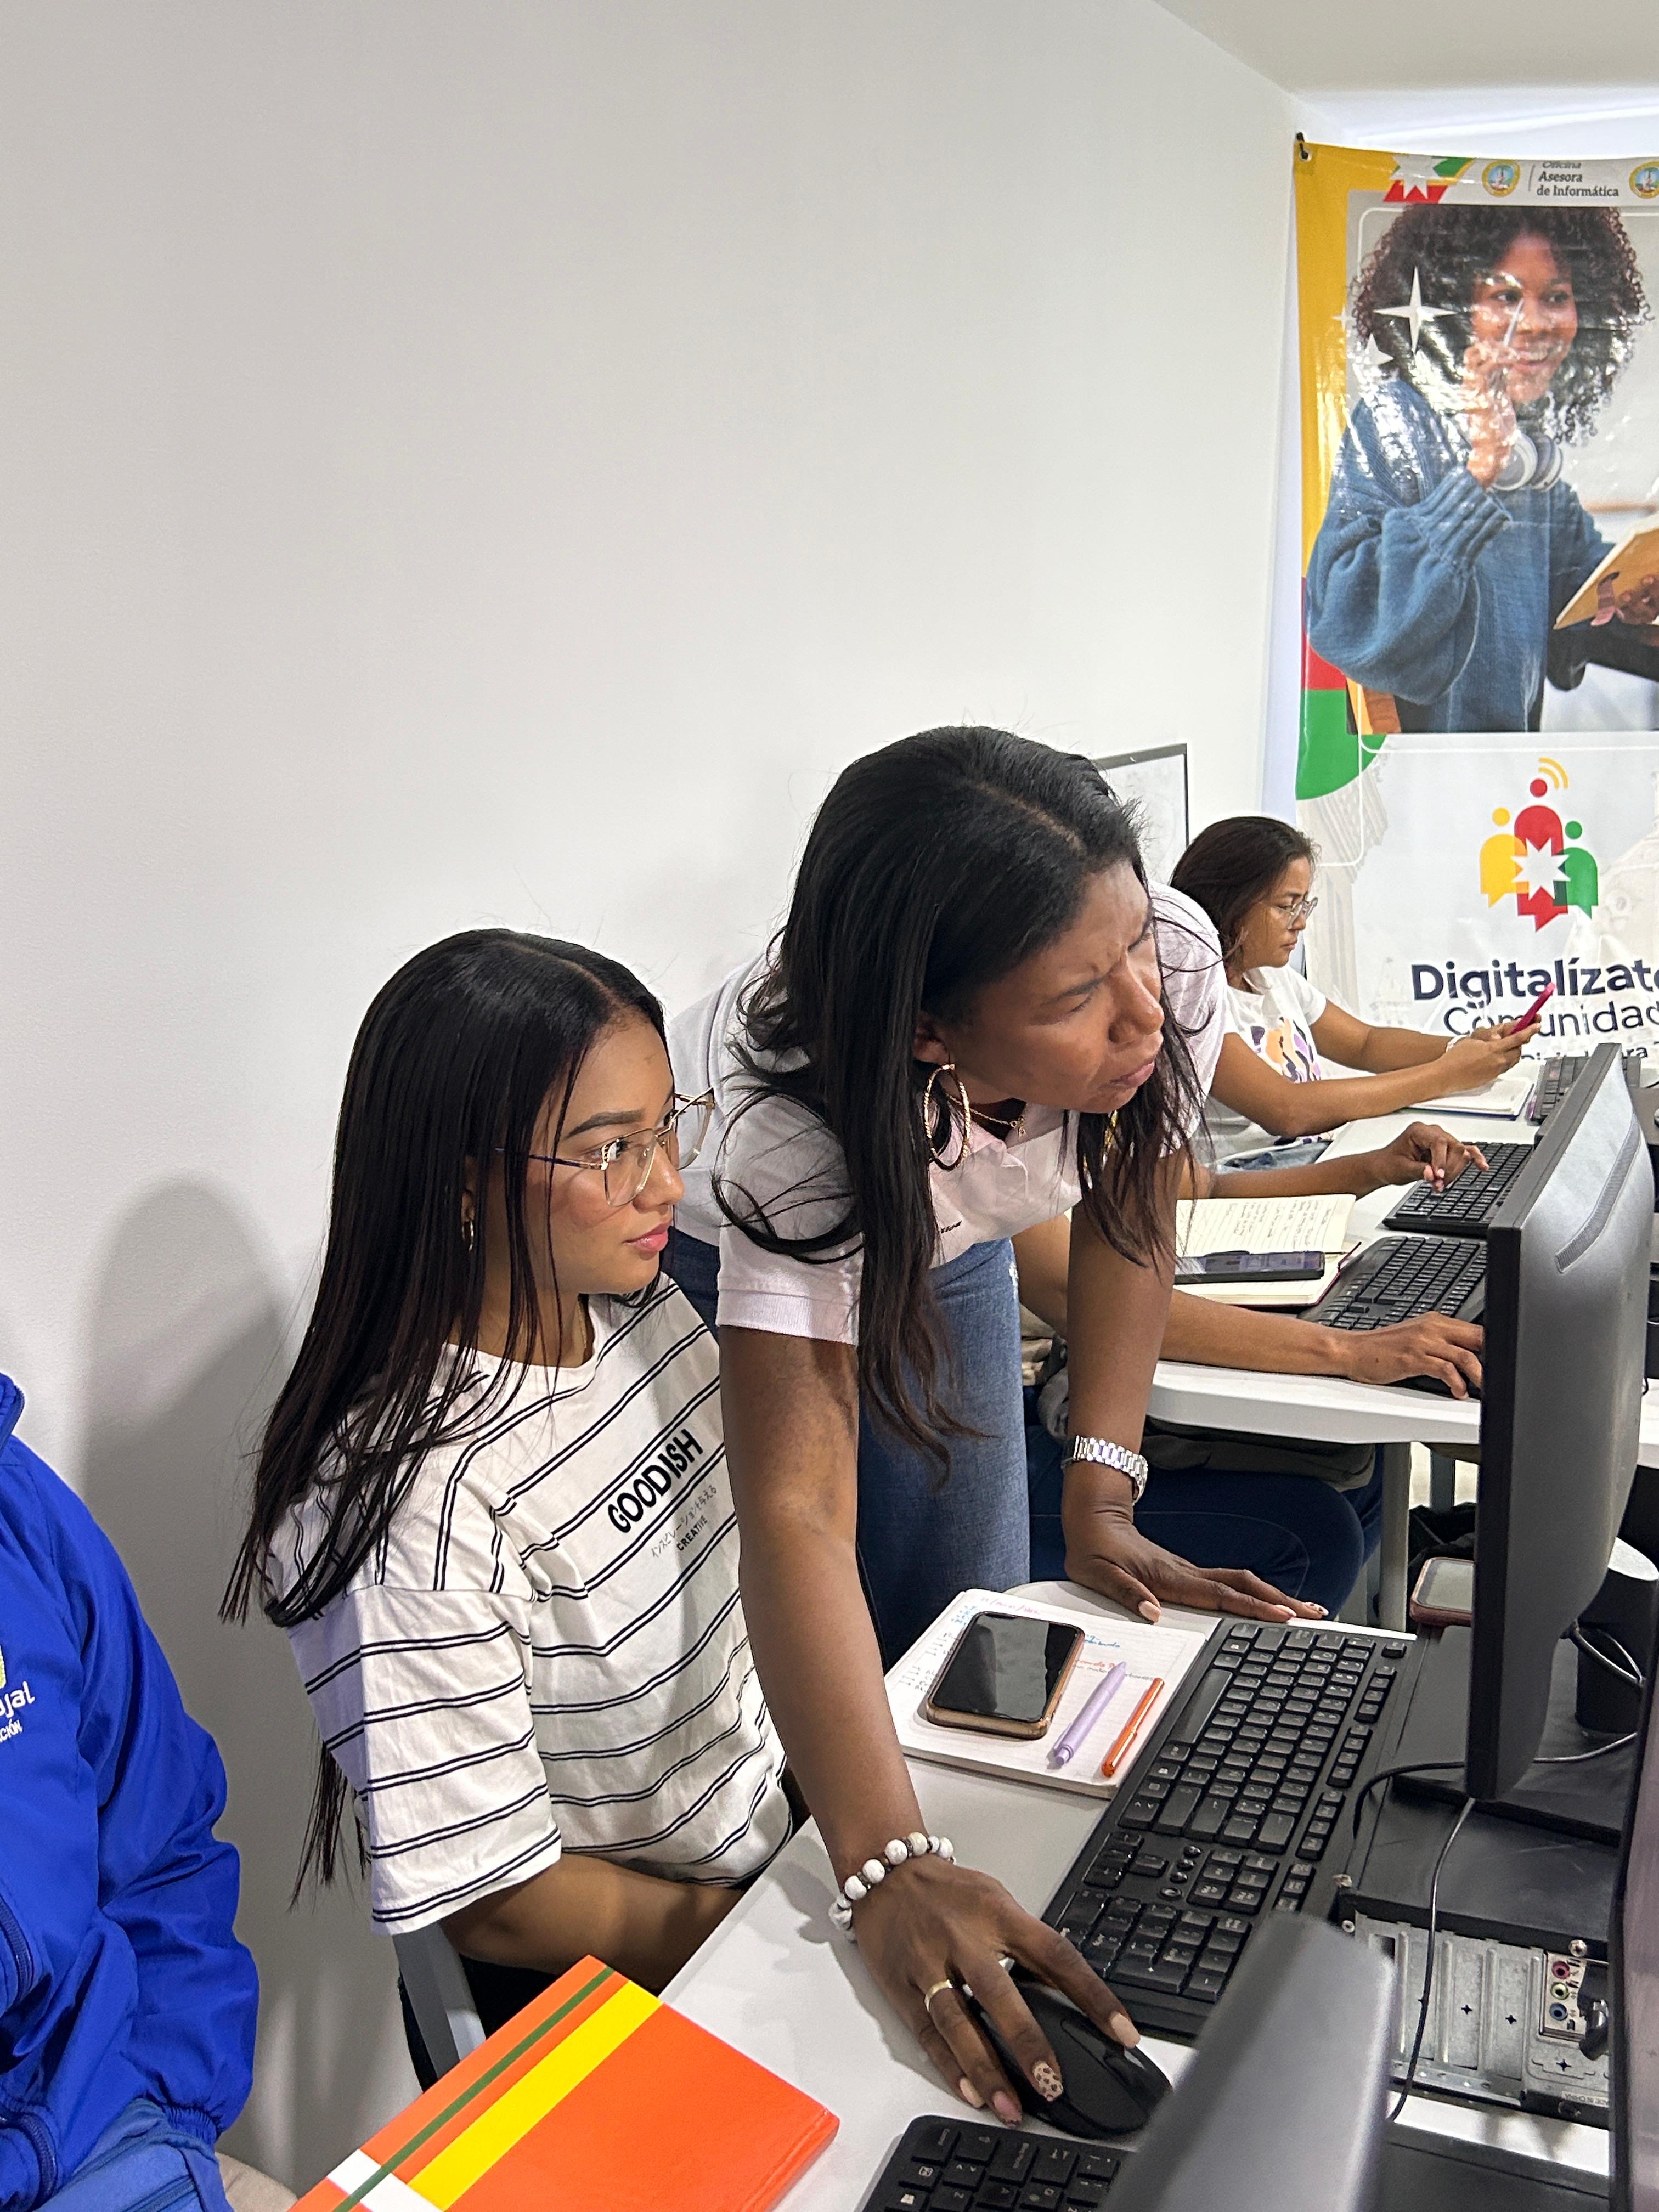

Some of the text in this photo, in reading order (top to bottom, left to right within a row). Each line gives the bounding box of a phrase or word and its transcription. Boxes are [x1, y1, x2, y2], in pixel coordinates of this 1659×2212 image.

[1536, 184, 1619, 197] de Informática
[1538, 171, 1582, 182] Asesora
[1411, 957, 1659, 1009] Digitalízat
[607, 1429, 703, 1533] GOODISH
